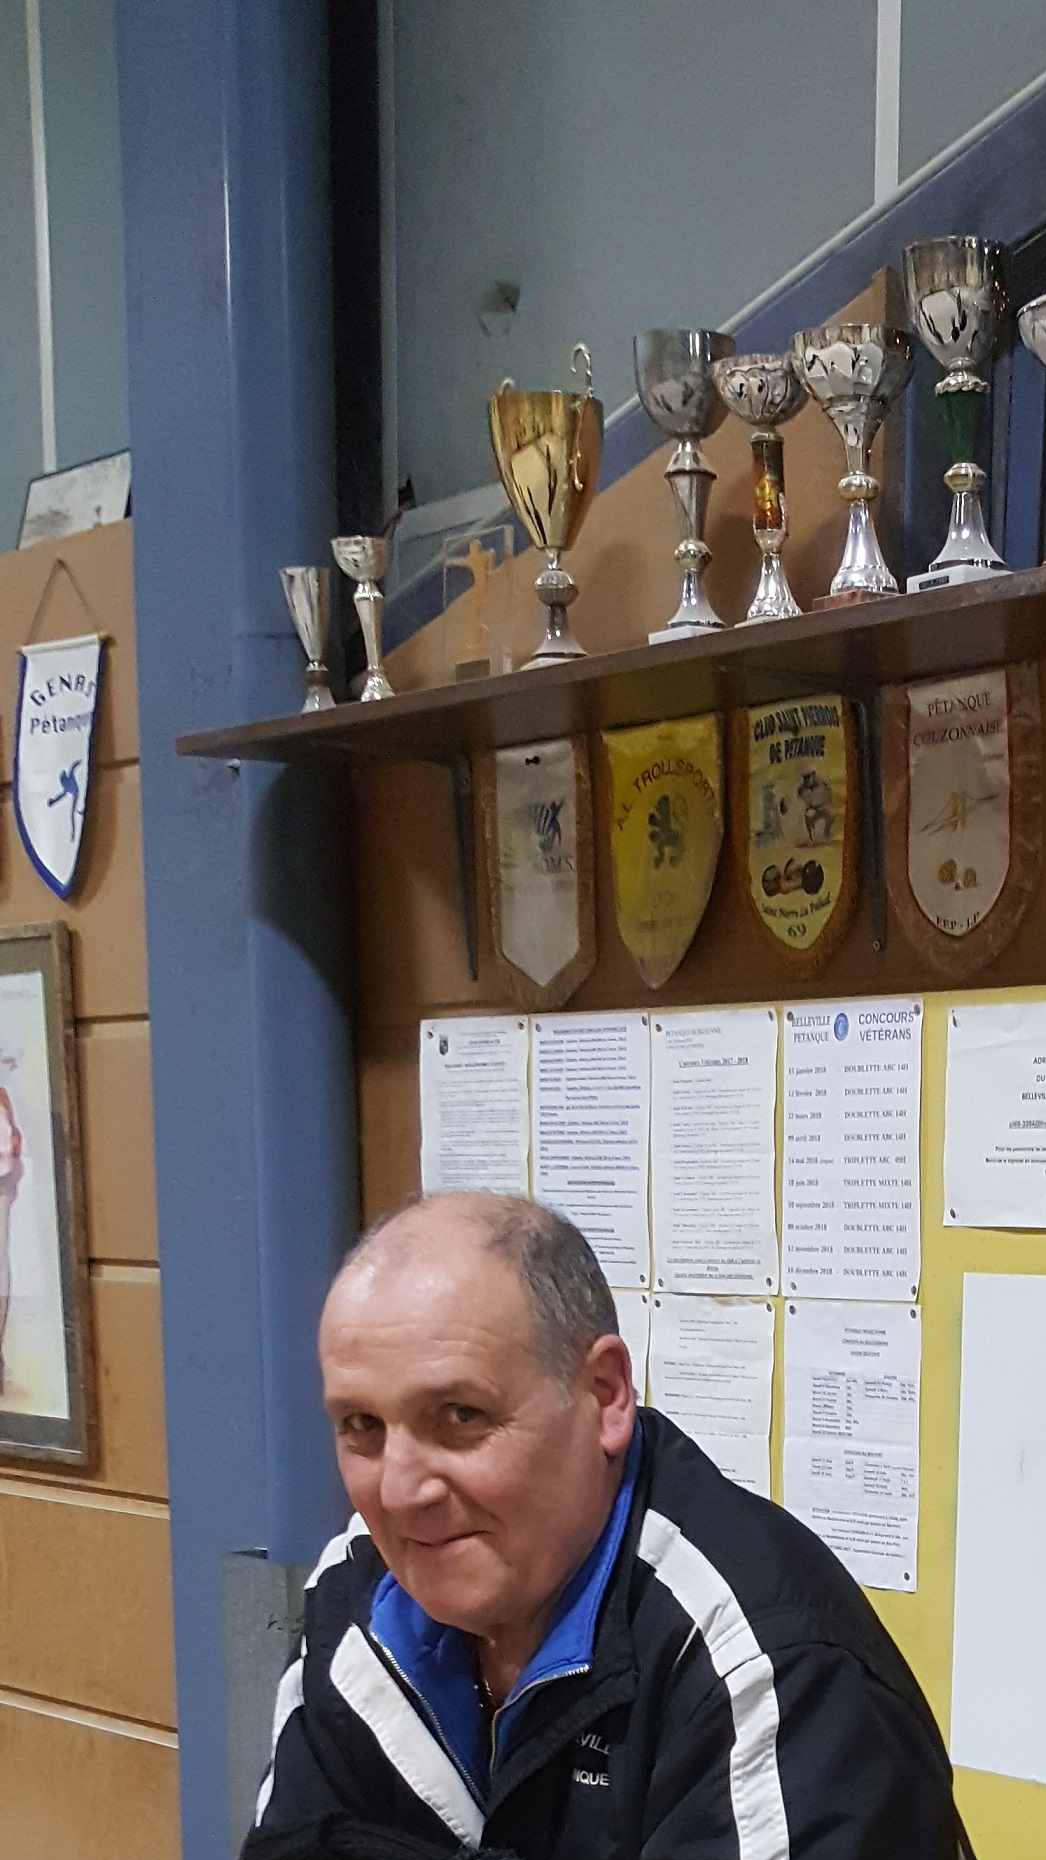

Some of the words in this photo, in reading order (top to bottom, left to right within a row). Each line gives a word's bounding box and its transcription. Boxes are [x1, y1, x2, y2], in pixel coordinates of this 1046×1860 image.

[791, 1015, 831, 1027] BELLEVILLE
[858, 1011, 915, 1025] CONCOURS
[860, 1028, 912, 1042] VÉTÉRANS
[844, 1064, 881, 1073] DOUBLETTE
[883, 1063, 896, 1071] ABC
[1036, 1074, 1046, 1083] DU
[844, 1087, 880, 1096] DOUBLETTE
[882, 1086, 895, 1095] ABC
[844, 1110, 879, 1119] DOUBLETTE
[881, 1110, 893, 1118] ABC
[844, 1133, 880, 1141] DOUBLETTE
[882, 1133, 894, 1141] ABC
[843, 1156, 876, 1164] TRIPLETTE
[879, 1156, 891, 1164] ABC
[843, 1179, 878, 1187] TRIPLETTE
[878, 1179, 899, 1187] MIXTE
[843, 1224, 881, 1232] DOUBLETTE
[882, 1224, 895, 1232] ABC
[843, 1246, 880, 1254] DOUBLETTE
[882, 1247, 894, 1255] ABC
[843, 1268, 879, 1277] DOUBLETTE
[882, 1269, 893, 1277] ABC
